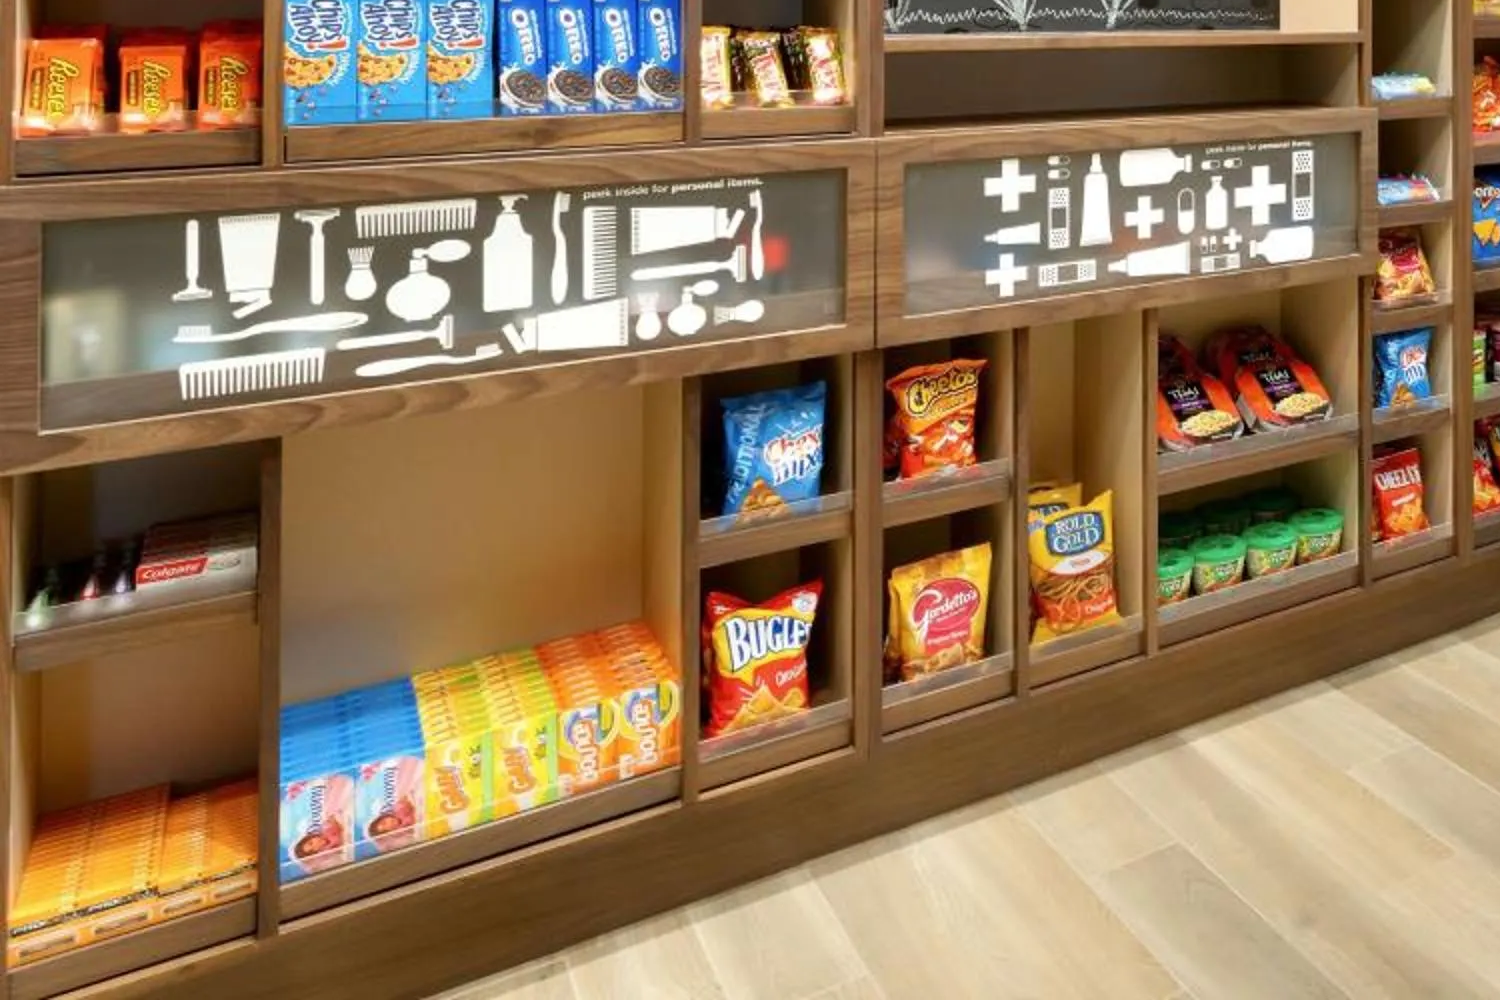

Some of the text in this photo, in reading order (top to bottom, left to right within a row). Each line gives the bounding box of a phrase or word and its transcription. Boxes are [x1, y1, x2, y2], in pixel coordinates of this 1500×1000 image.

[511, 8, 536, 65] OREO
[559, 8, 582, 65] OREO
[605, 8, 628, 63] OREO
[650, 7, 671, 62] OREO
[671, 179, 725, 194] personal
[908, 367, 976, 414] Cheetos
[1053, 527, 1099, 553] GOLD
[1055, 513, 1096, 534] ROLD
[143, 563, 200, 580] Colgate
